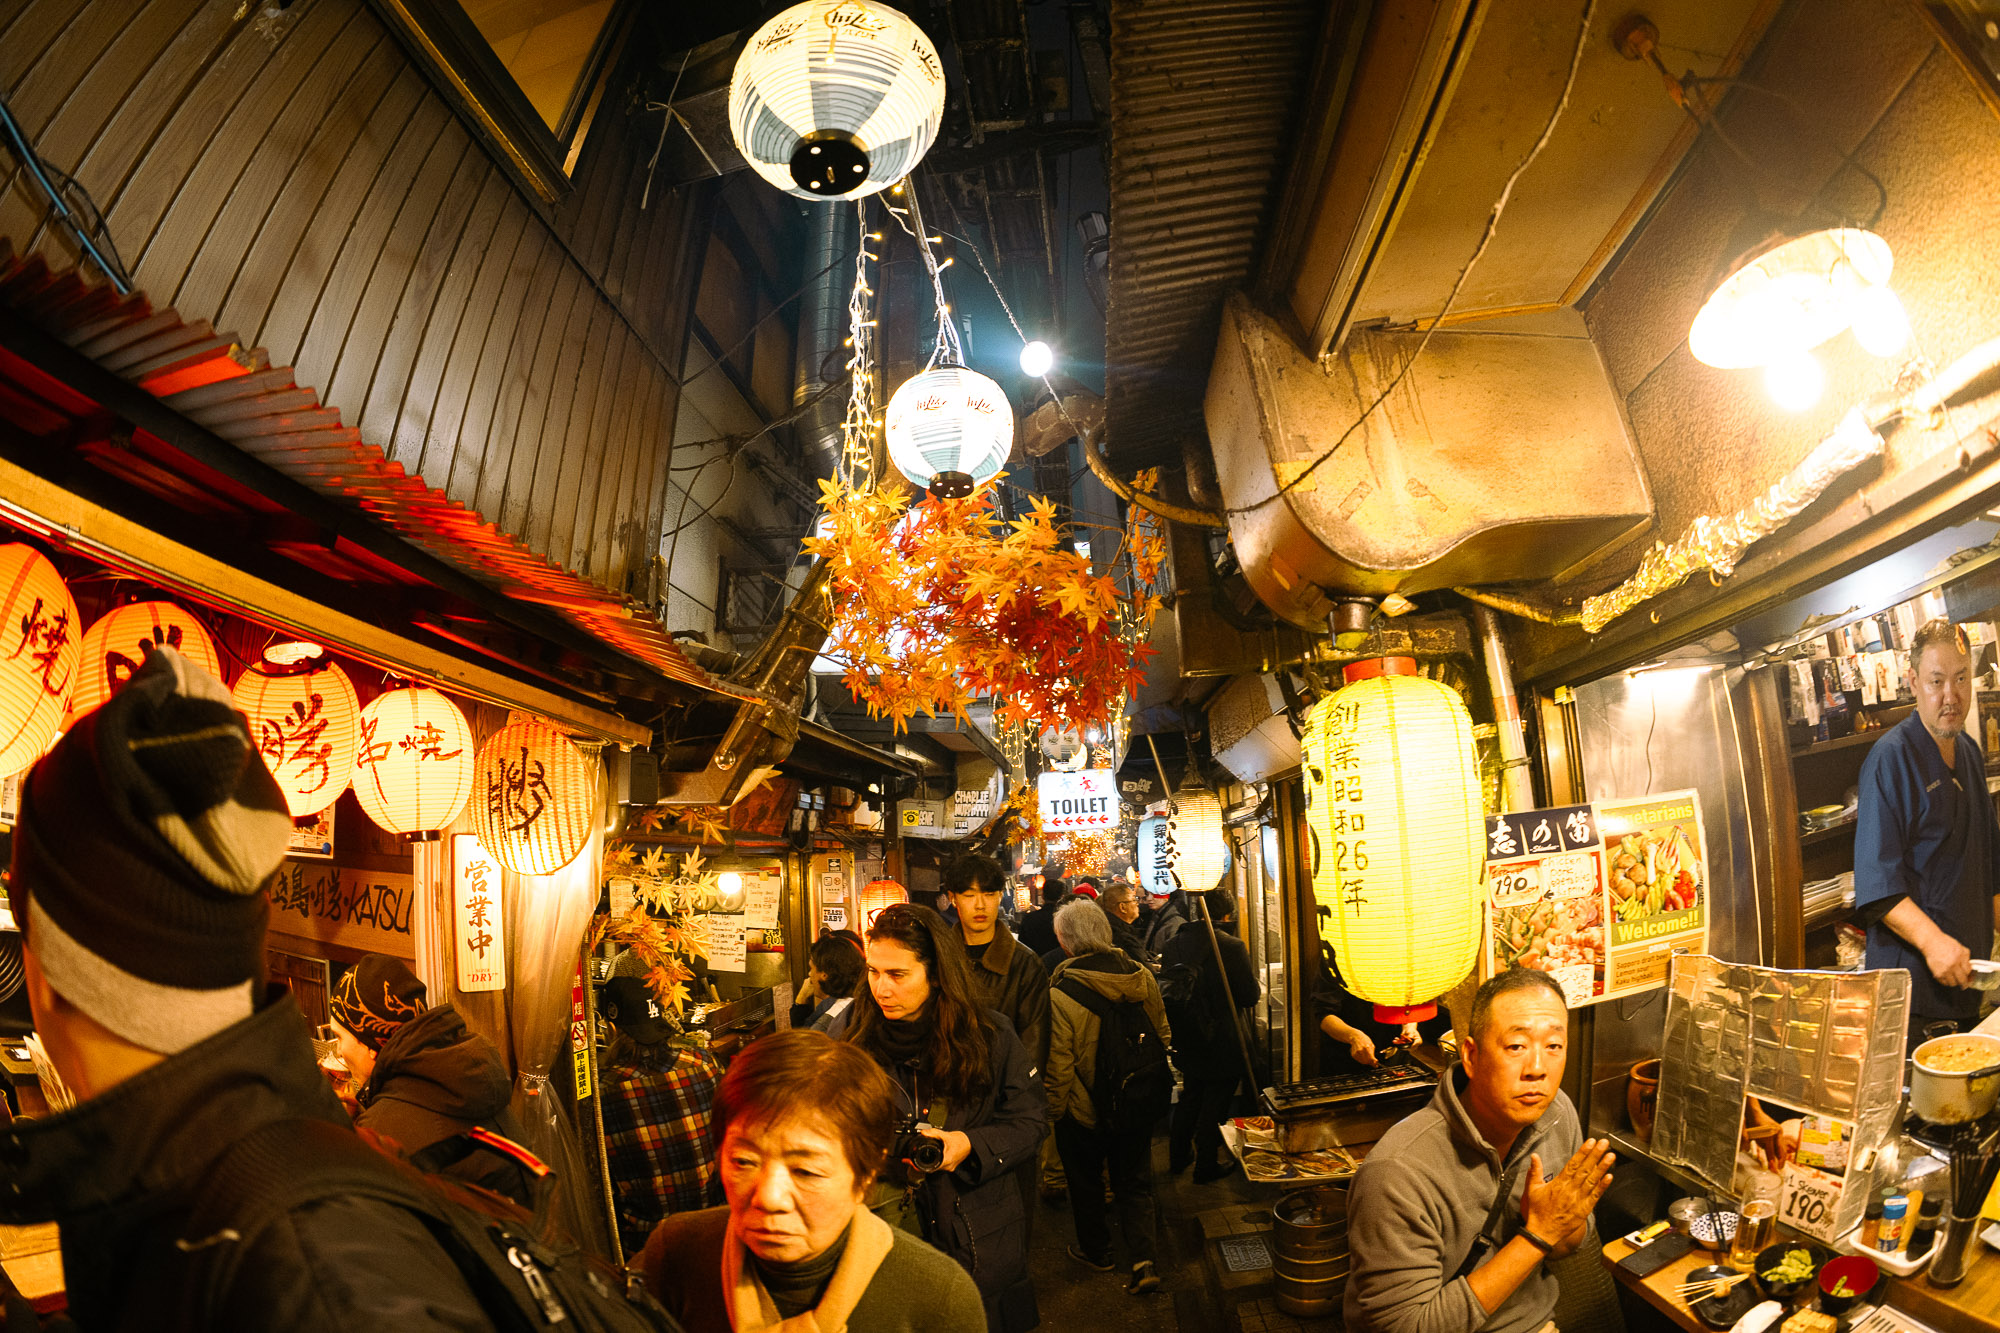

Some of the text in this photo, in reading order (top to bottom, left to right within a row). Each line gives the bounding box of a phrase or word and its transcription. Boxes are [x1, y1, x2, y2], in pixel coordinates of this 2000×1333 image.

[954, 790, 989, 804] CHARLIE
[1050, 797, 1108, 815] TOILET
[1326, 701, 1369, 917] 創業昭和26年
[1604, 804, 1694, 826] Vgetarians
[1489, 810, 1591, 855] 志の笛
[1495, 875, 1528, 895] 190
[464, 860, 494, 960] 営業中
[1618, 910, 1700, 942] Welcome!!
[1641, 954, 1656, 965] draft
[1656, 952, 1669, 961] beer
[1616, 966, 1650, 978] Lemon sour
[1631, 972, 1654, 985] highball
[646, 999, 660, 1018] LA
[1785, 1190, 1825, 1224] 190
